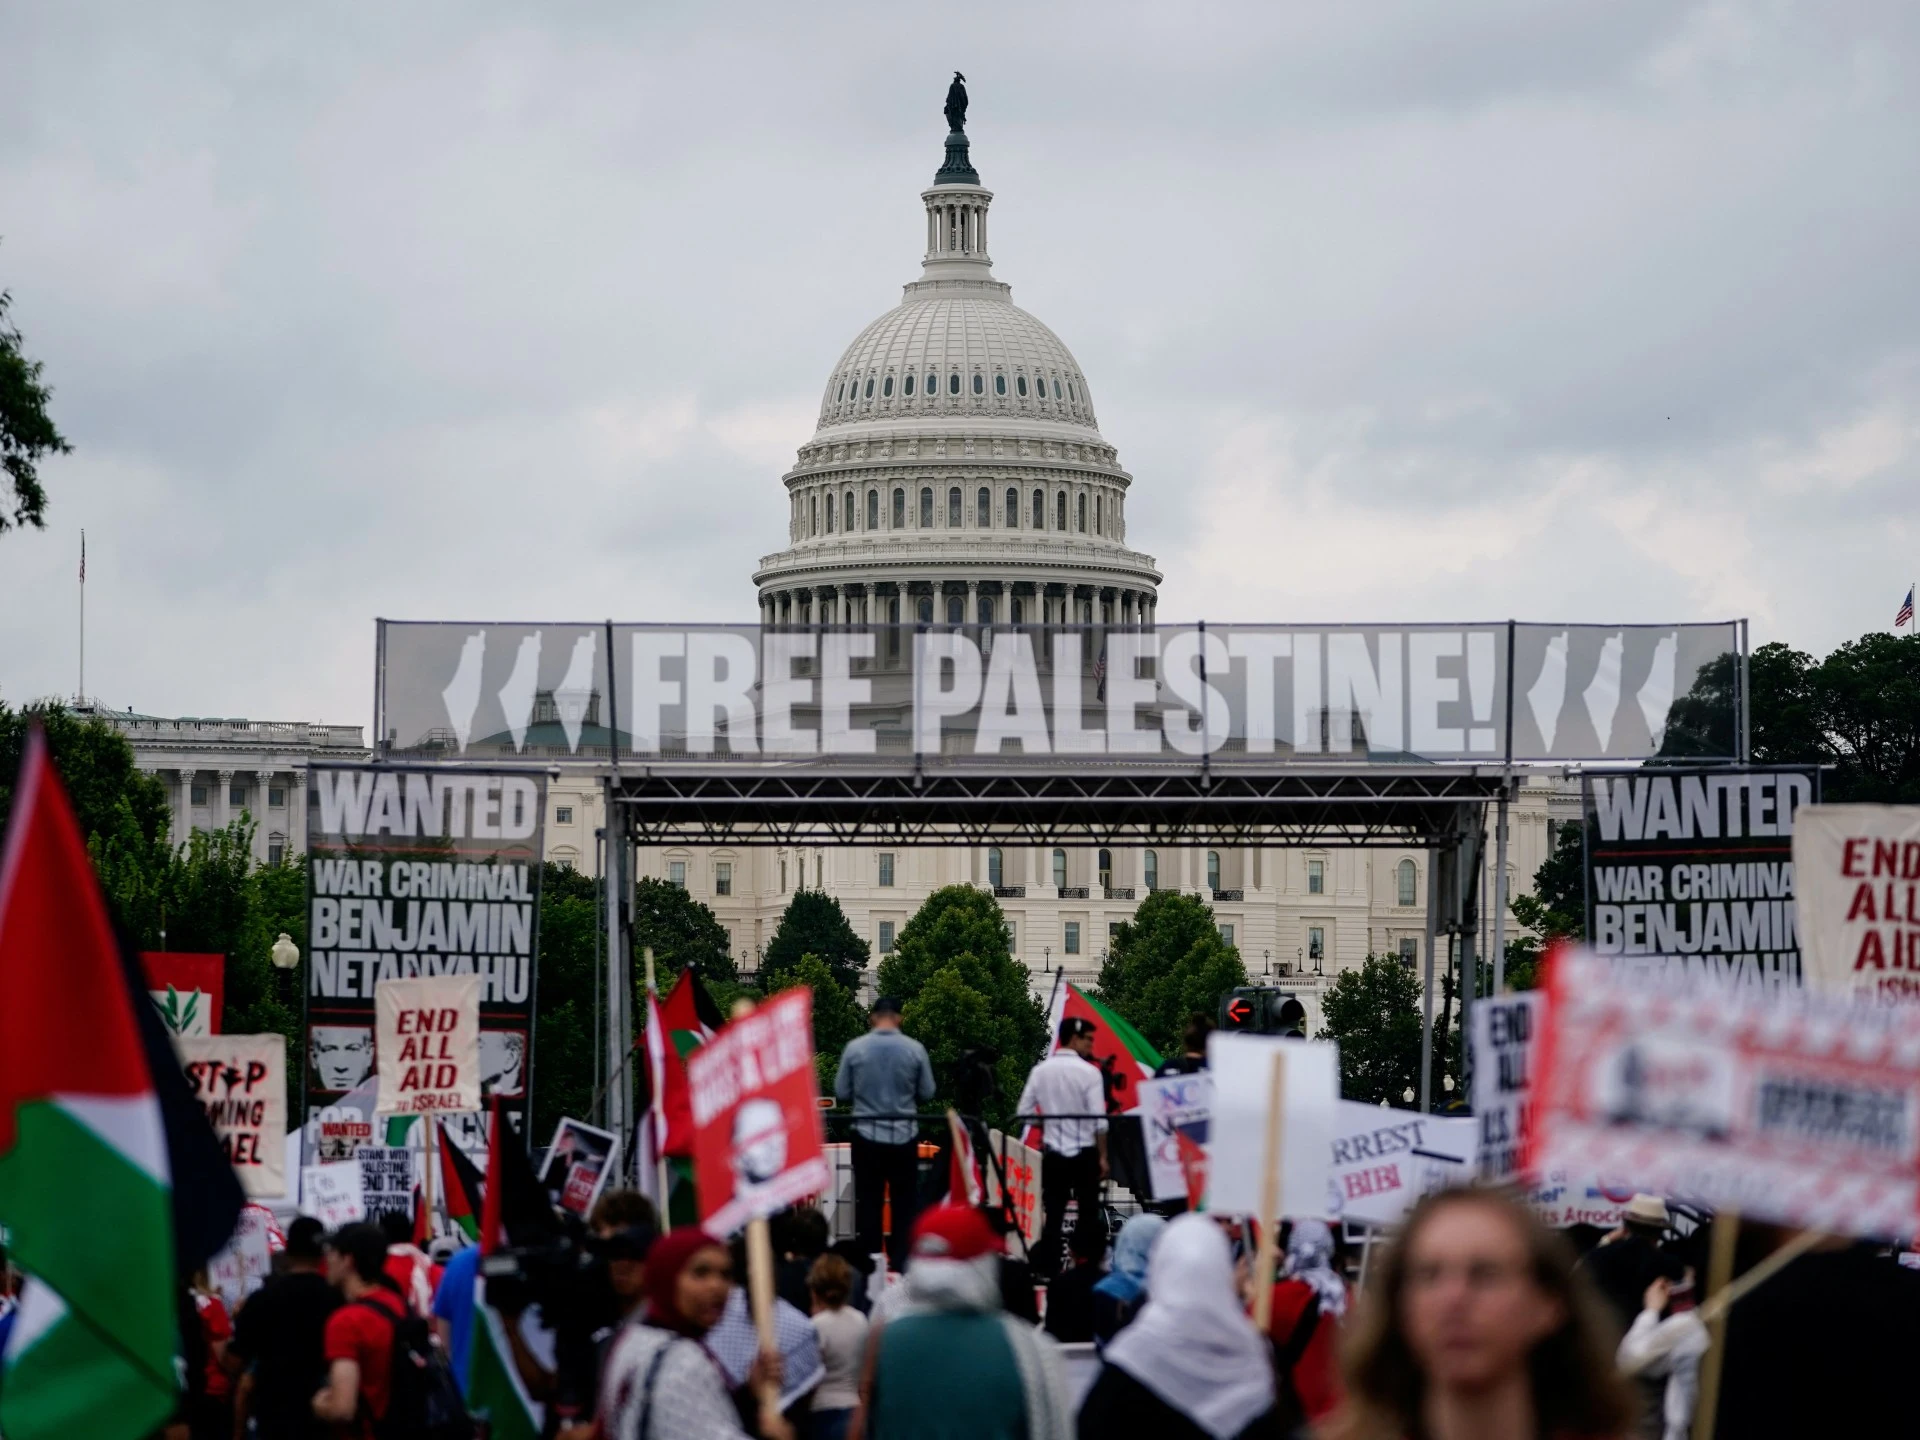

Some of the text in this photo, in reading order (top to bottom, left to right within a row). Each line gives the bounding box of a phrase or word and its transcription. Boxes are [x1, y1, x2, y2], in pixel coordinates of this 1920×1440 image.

[632, 631, 1496, 755] FREE PALESTINE!
[317, 771, 537, 839] WANTED
[1591, 773, 1811, 841] WANTED
[313, 859, 533, 901] WAR CRIMINAL
[1594, 862, 1797, 902] WAR CRIMINA
[311, 898, 533, 954] BENJAMIN
[397, 1008, 460, 1035] END
[399, 1035, 454, 1062] ALL
[400, 1063, 458, 1092] AID
[412, 1093, 464, 1111] ISRAEL
[322, 1122, 372, 1137] WANTED
[1331, 1120, 1427, 1165] RREST
[1343, 1163, 1403, 1200] BIBI
[1564, 1206, 1628, 1224] Atroci
